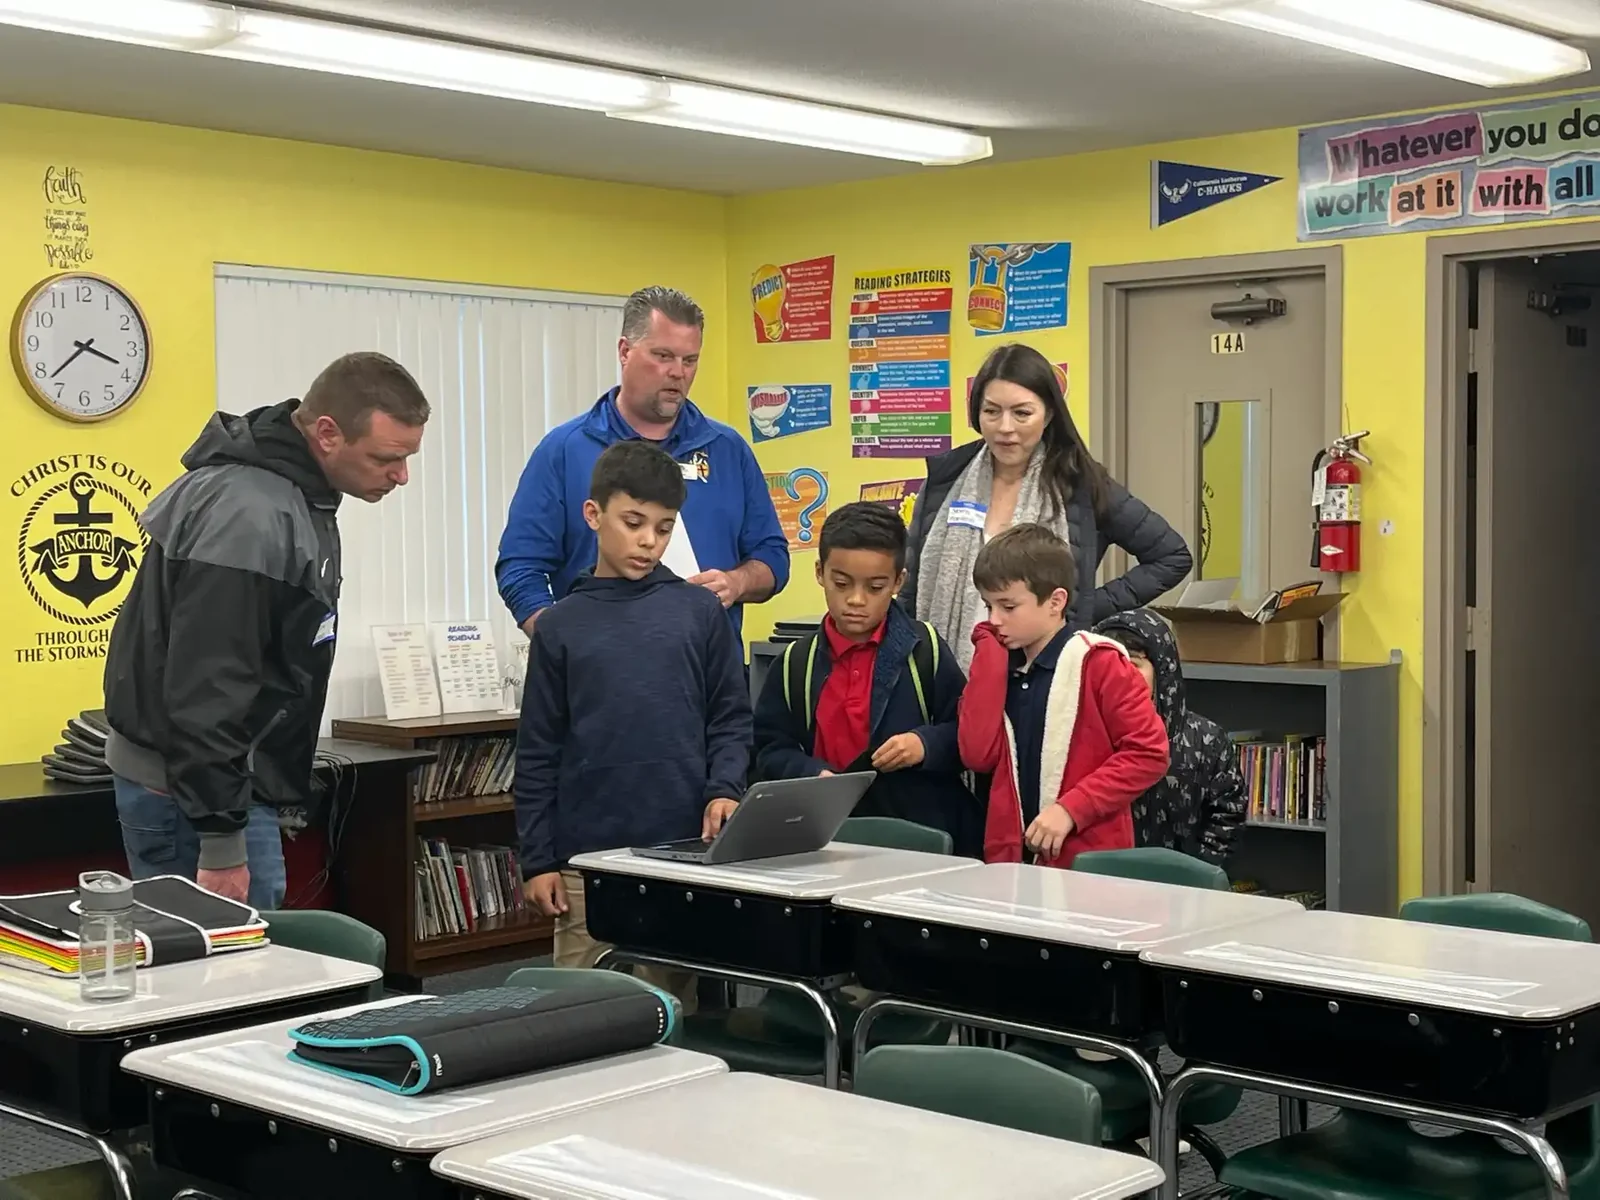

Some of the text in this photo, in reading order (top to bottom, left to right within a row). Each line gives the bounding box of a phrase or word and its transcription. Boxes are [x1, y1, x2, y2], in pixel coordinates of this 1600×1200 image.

[1331, 108, 1600, 173] Whatever you do
[1193, 176, 1247, 187] California Lutheran
[1197, 183, 1242, 197] C-HAWKS
[1315, 165, 1593, 217] work at it with all
[854, 270, 951, 290] READING STRATEGIES
[76, 285, 92, 303] 12
[752, 275, 783, 303] PREDICT
[52, 292, 66, 309] 11
[105, 294, 110, 310] 1
[968, 296, 1004, 312] CONNECT
[35, 311, 53, 328] 10
[120, 315, 130, 331] 2
[28, 335, 39, 352] 9
[127, 341, 137, 357] 3
[1214, 333, 1243, 353] 14A
[35, 362, 47, 378] 8
[121, 368, 131, 382] 4
[55, 383, 65, 399] 7
[79, 391, 90, 407] 6
[104, 385, 115, 401] 5
[11, 454, 152, 498] CHRIST IS OUR
[58, 531, 112, 554] ANCHOR
[35, 629, 109, 646] THROUGH
[447, 633, 481, 641] SCHEDULE
[14, 644, 106, 663] THE STORMS
